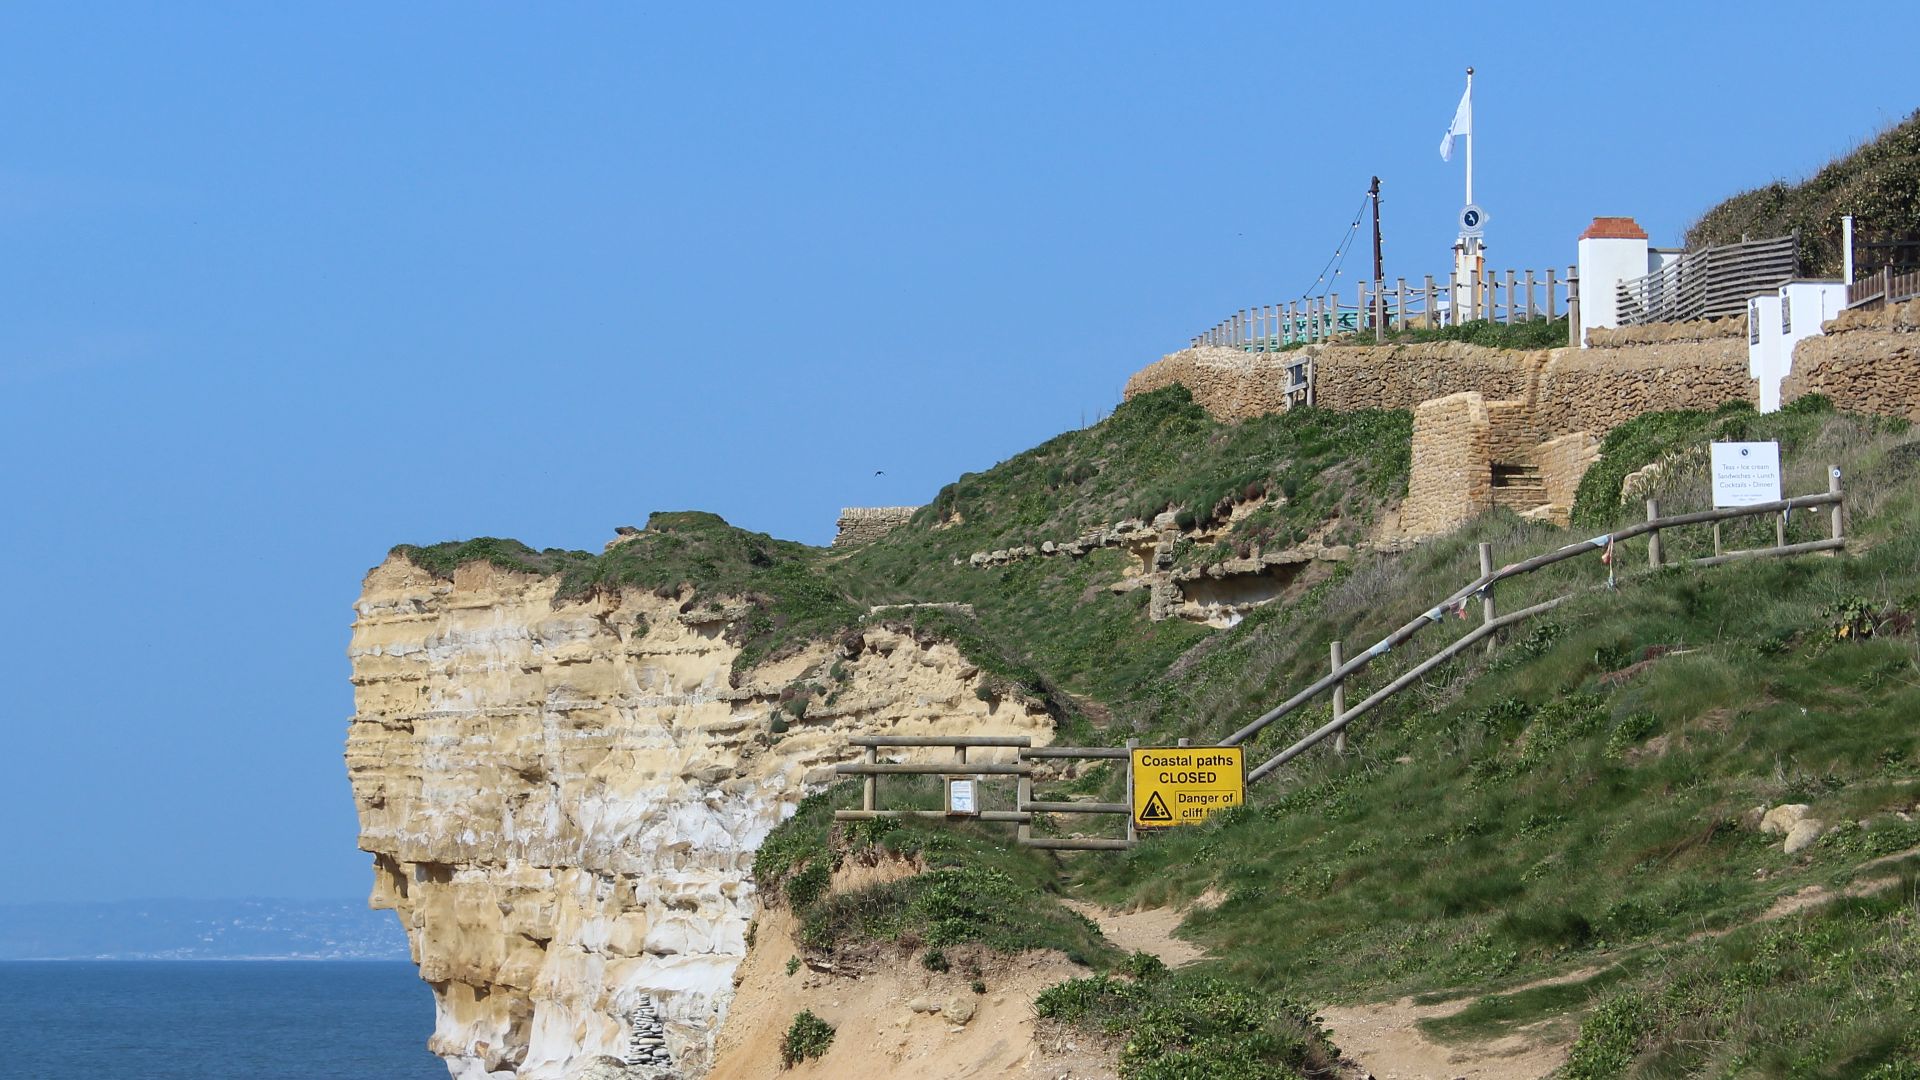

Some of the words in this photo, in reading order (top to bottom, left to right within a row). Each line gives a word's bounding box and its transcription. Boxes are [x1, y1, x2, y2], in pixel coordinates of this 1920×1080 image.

[1142, 755, 1192, 767] Coastal
[1196, 755, 1233, 768] paths
[1159, 772, 1217, 783] CLOSED
[1178, 793, 1219, 805] Danger
[1222, 793, 1234, 802] of
[1182, 807, 1203, 817] cliff
